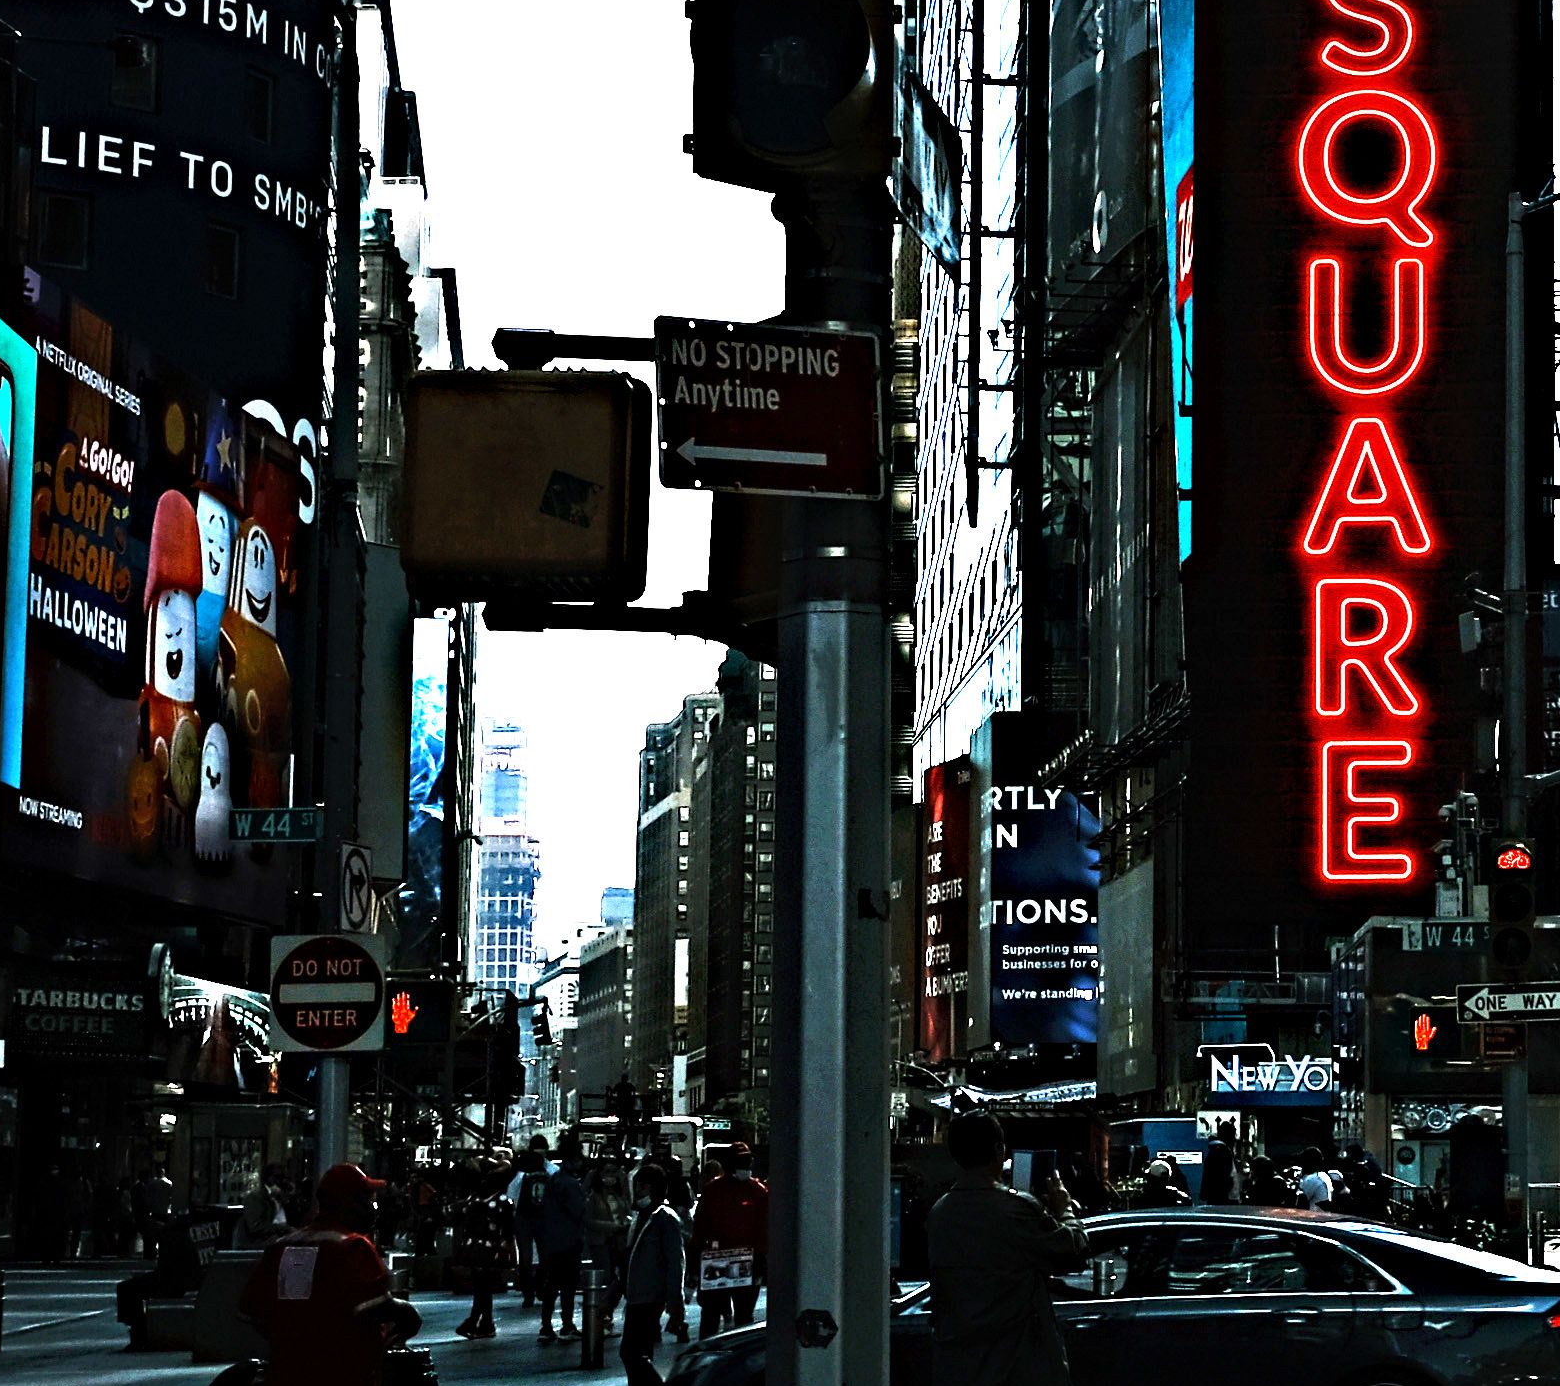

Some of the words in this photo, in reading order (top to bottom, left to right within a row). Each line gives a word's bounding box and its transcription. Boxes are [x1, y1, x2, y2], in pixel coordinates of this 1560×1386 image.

[283, 19, 307, 67] IN
[179, 150, 234, 199] TO
[42, 338, 77, 378] NETFLIX
[671, 336, 707, 370] NO
[714, 338, 841, 379] STOPPING
[674, 375, 781, 413] Anytime
[28, 571, 129, 655] HALLOWEEN
[234, 812, 252, 838] W
[260, 811, 292, 838] 44
[926, 877, 964, 906] BENEFITS
[1425, 925, 1442, 948] W
[1451, 925, 1475, 948] 44
[1001, 944, 1071, 957] Supporting
[291, 959, 322, 979] DO
[325, 958, 362, 978] NOT
[1001, 958, 1068, 971] businesses
[1069, 958, 1089, 970] for
[13, 987, 145, 1012] TARBUCKS
[1001, 988, 1038, 1001] We're
[1039, 987, 1094, 1002] standing
[1474, 993, 1509, 1012] ONE
[1521, 991, 1558, 1010] WAY
[24, 1012, 115, 1034] COFFEE
[295, 1008, 358, 1030] ENTER
